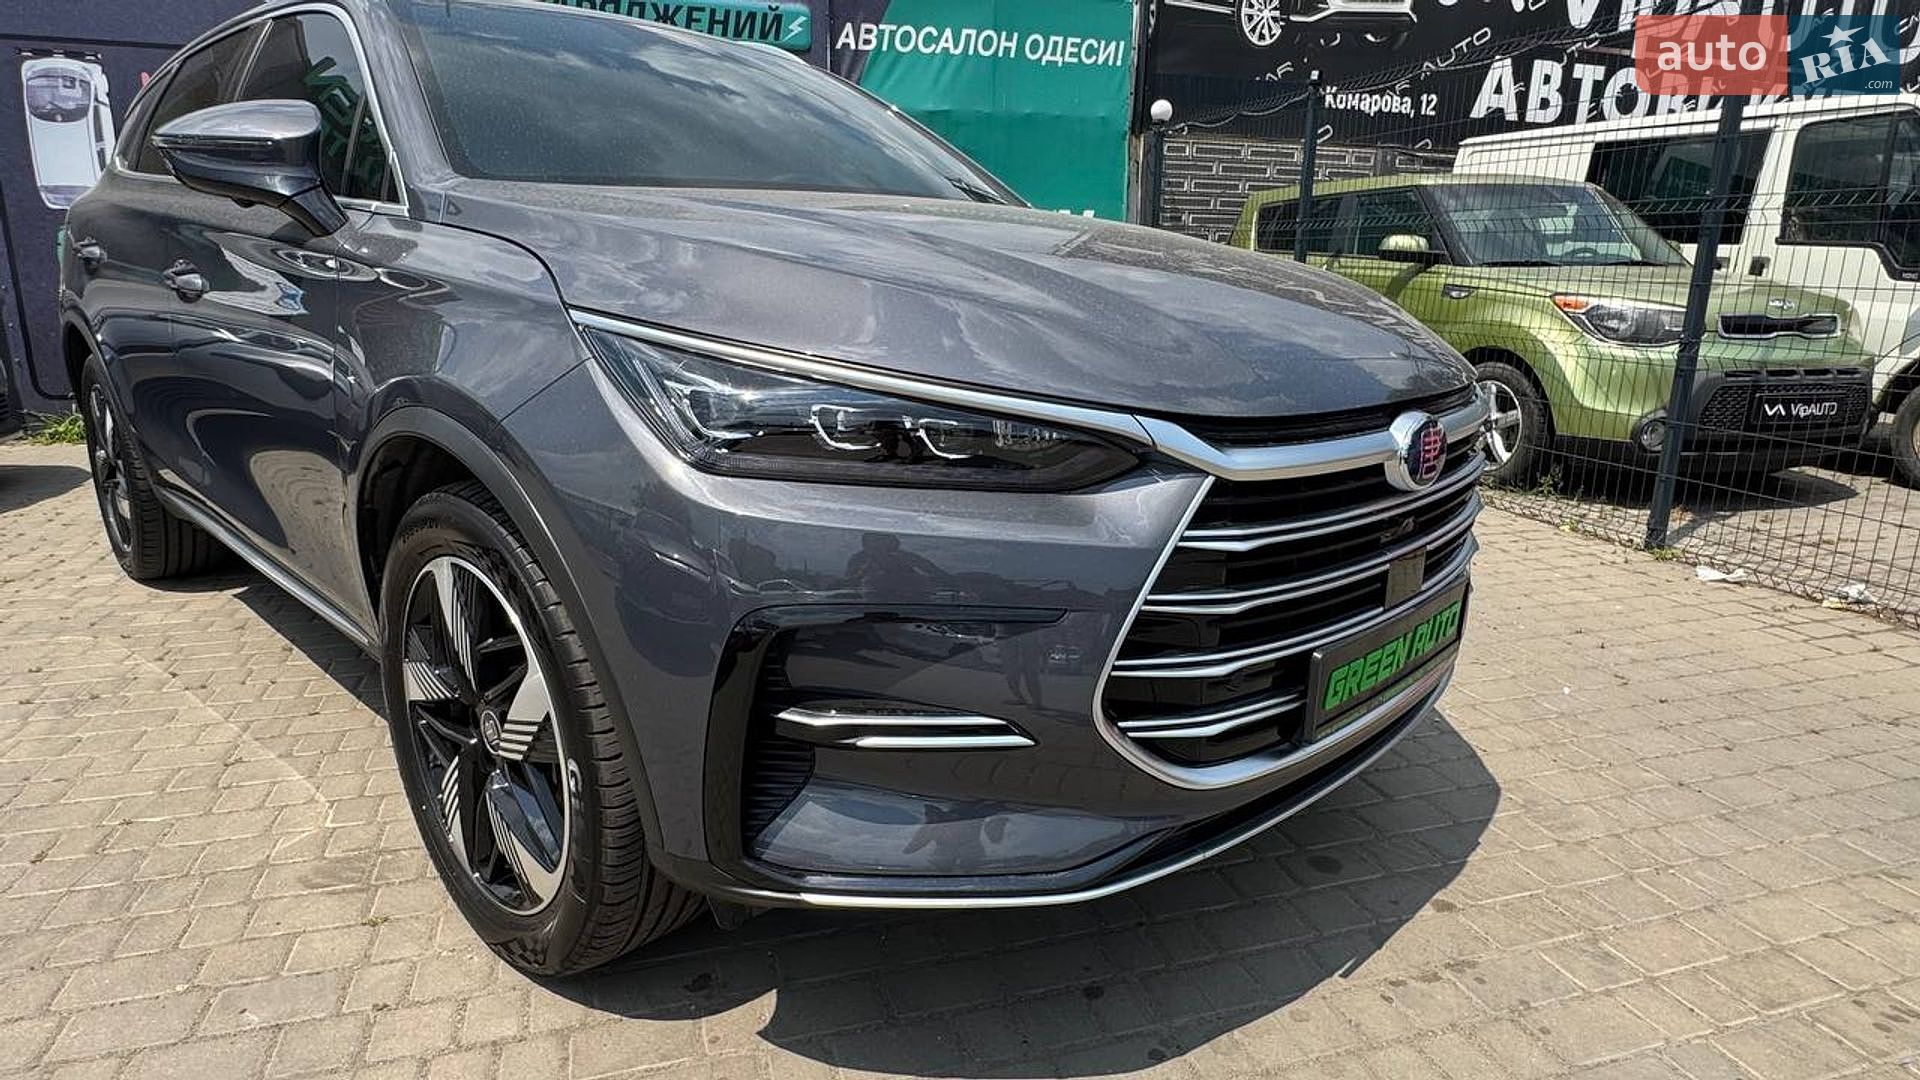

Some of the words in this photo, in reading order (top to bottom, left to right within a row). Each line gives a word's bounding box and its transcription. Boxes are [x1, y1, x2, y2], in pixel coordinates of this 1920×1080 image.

[836, 22, 1019, 59] АВТОСАЛОН
[1025, 32, 1125, 68] ОДЕСИ!
[1324, 86, 1415, 118] Комарова,
[1420, 93, 1437, 116] 12
[1324, 633, 1412, 711] GREEN
[1409, 599, 1463, 661] AUTO
